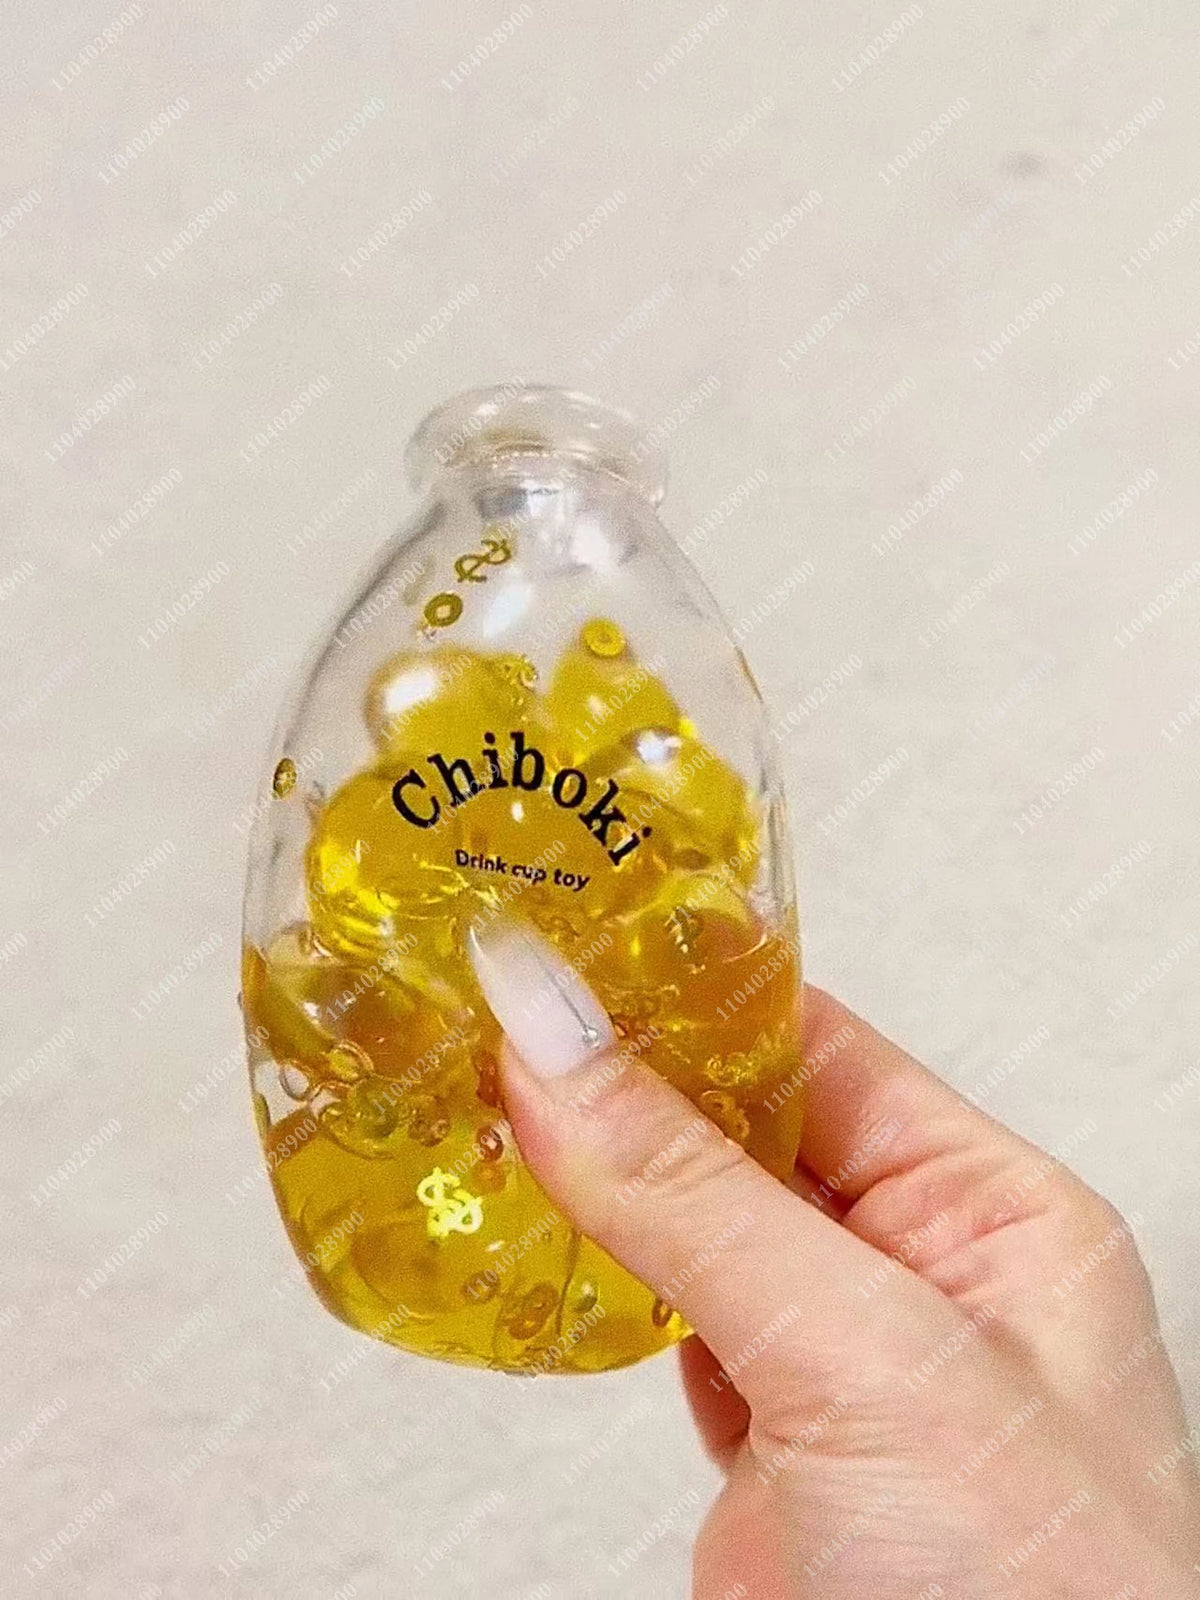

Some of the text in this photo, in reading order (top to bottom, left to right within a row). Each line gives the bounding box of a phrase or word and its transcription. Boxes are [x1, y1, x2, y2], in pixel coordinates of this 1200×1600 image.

[392, 731, 651, 866] Chiboki
[454, 848, 591, 893] Drink cup toy
